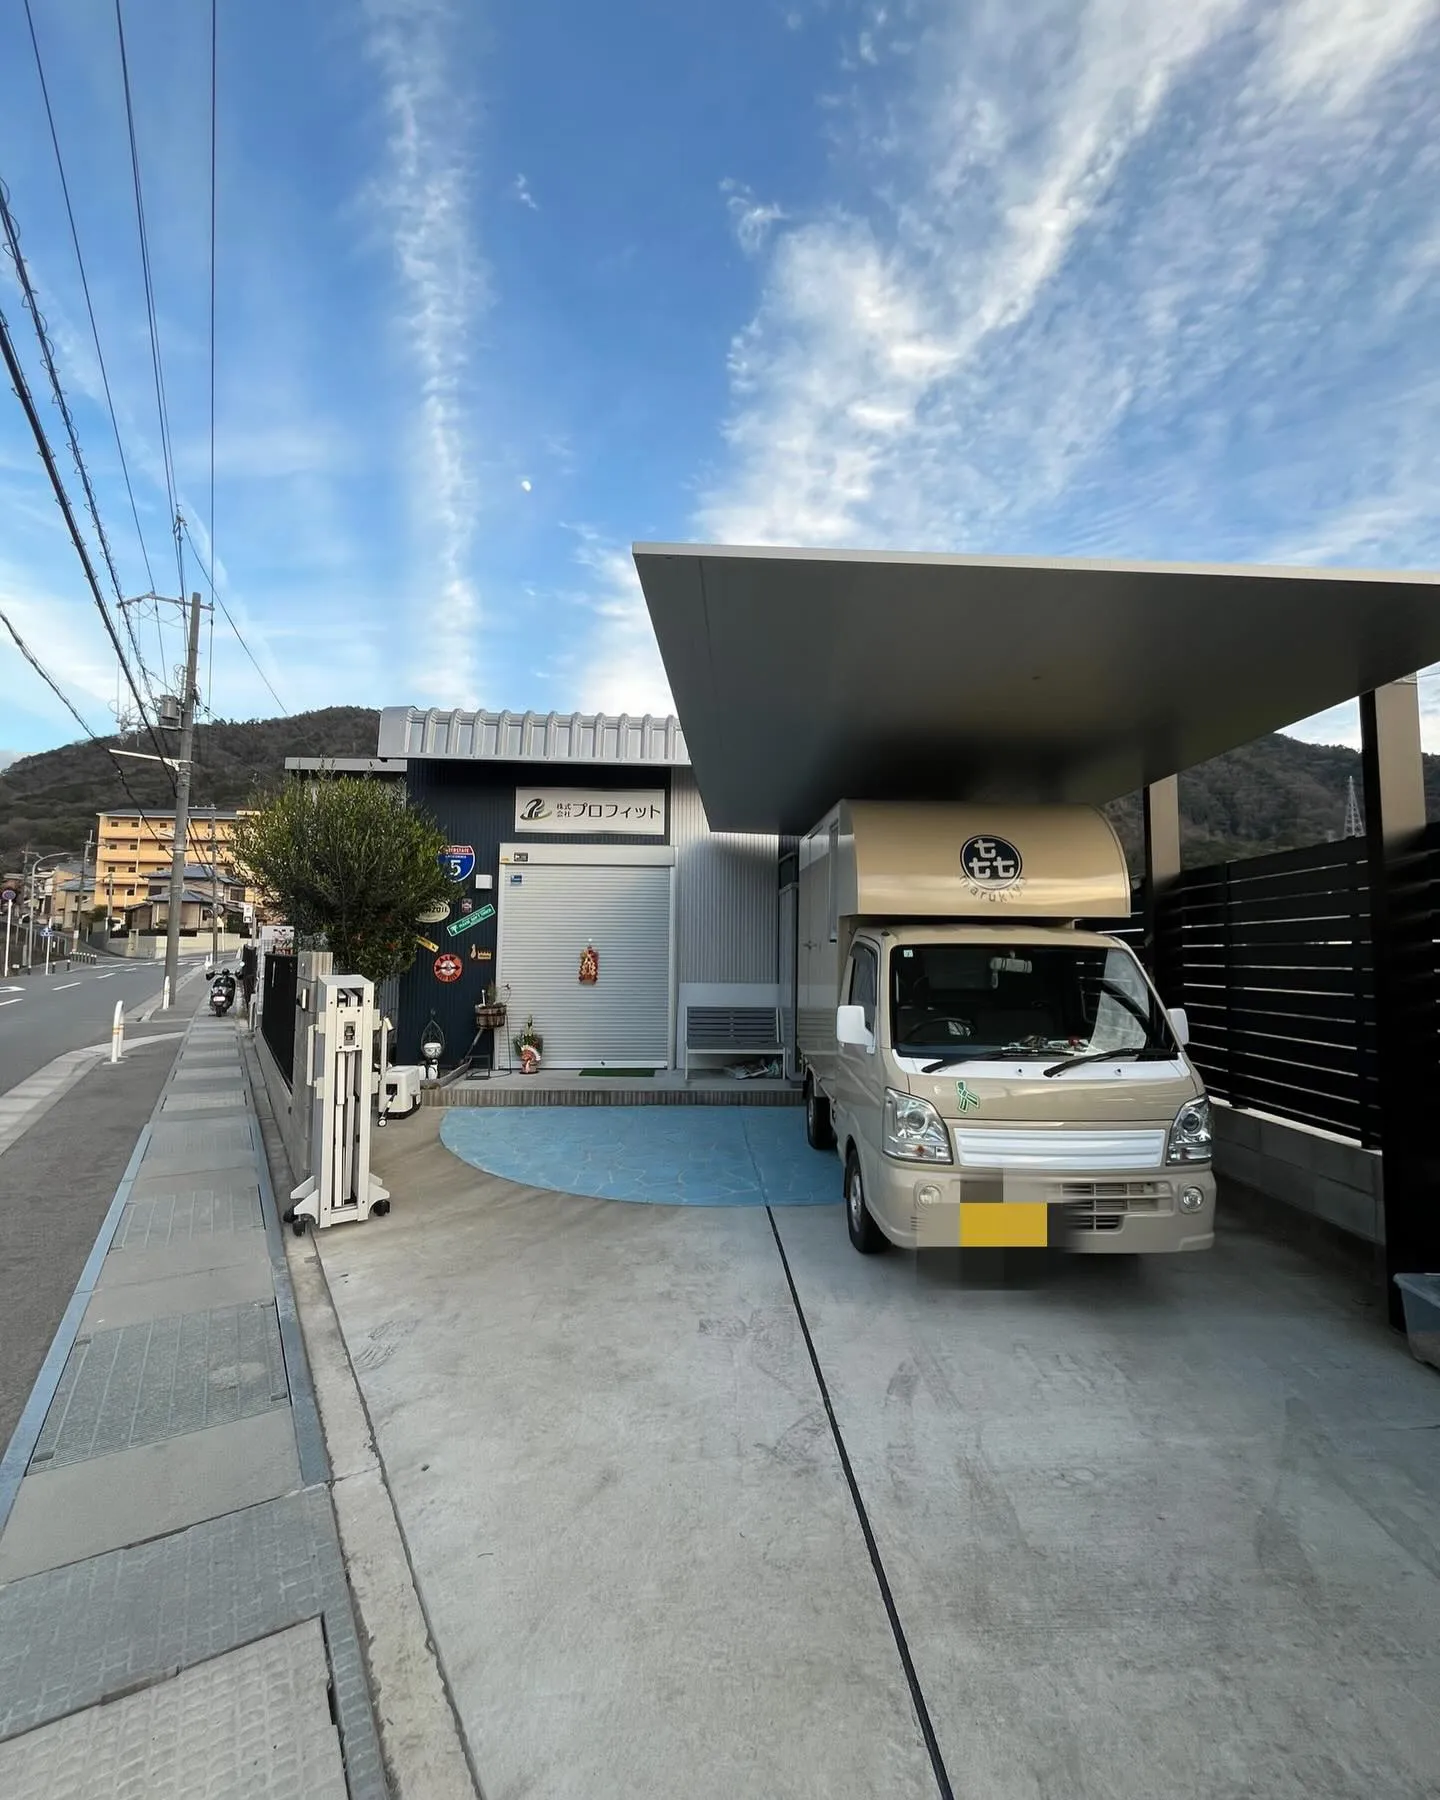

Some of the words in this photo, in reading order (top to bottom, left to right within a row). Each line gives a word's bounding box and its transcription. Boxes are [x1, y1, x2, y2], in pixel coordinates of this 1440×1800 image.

[573, 802, 661, 819] プロフィット
[450, 860, 461, 876] 5
